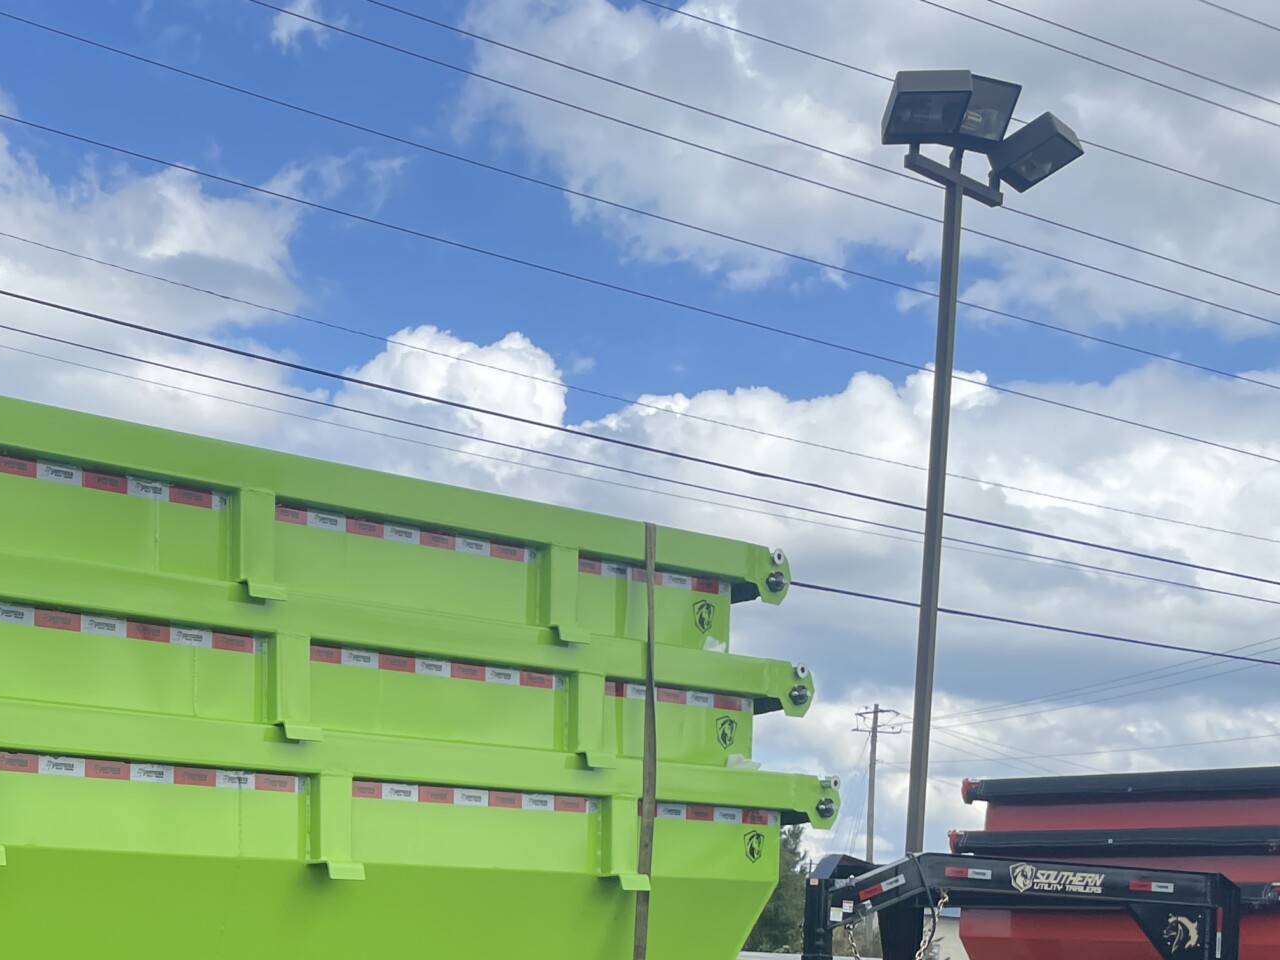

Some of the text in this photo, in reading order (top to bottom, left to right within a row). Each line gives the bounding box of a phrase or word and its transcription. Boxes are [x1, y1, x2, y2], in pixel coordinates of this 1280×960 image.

[1033, 870, 1105, 886] SOUTHERN
[1034, 882, 1102, 894] UTILITY TRAILERS
